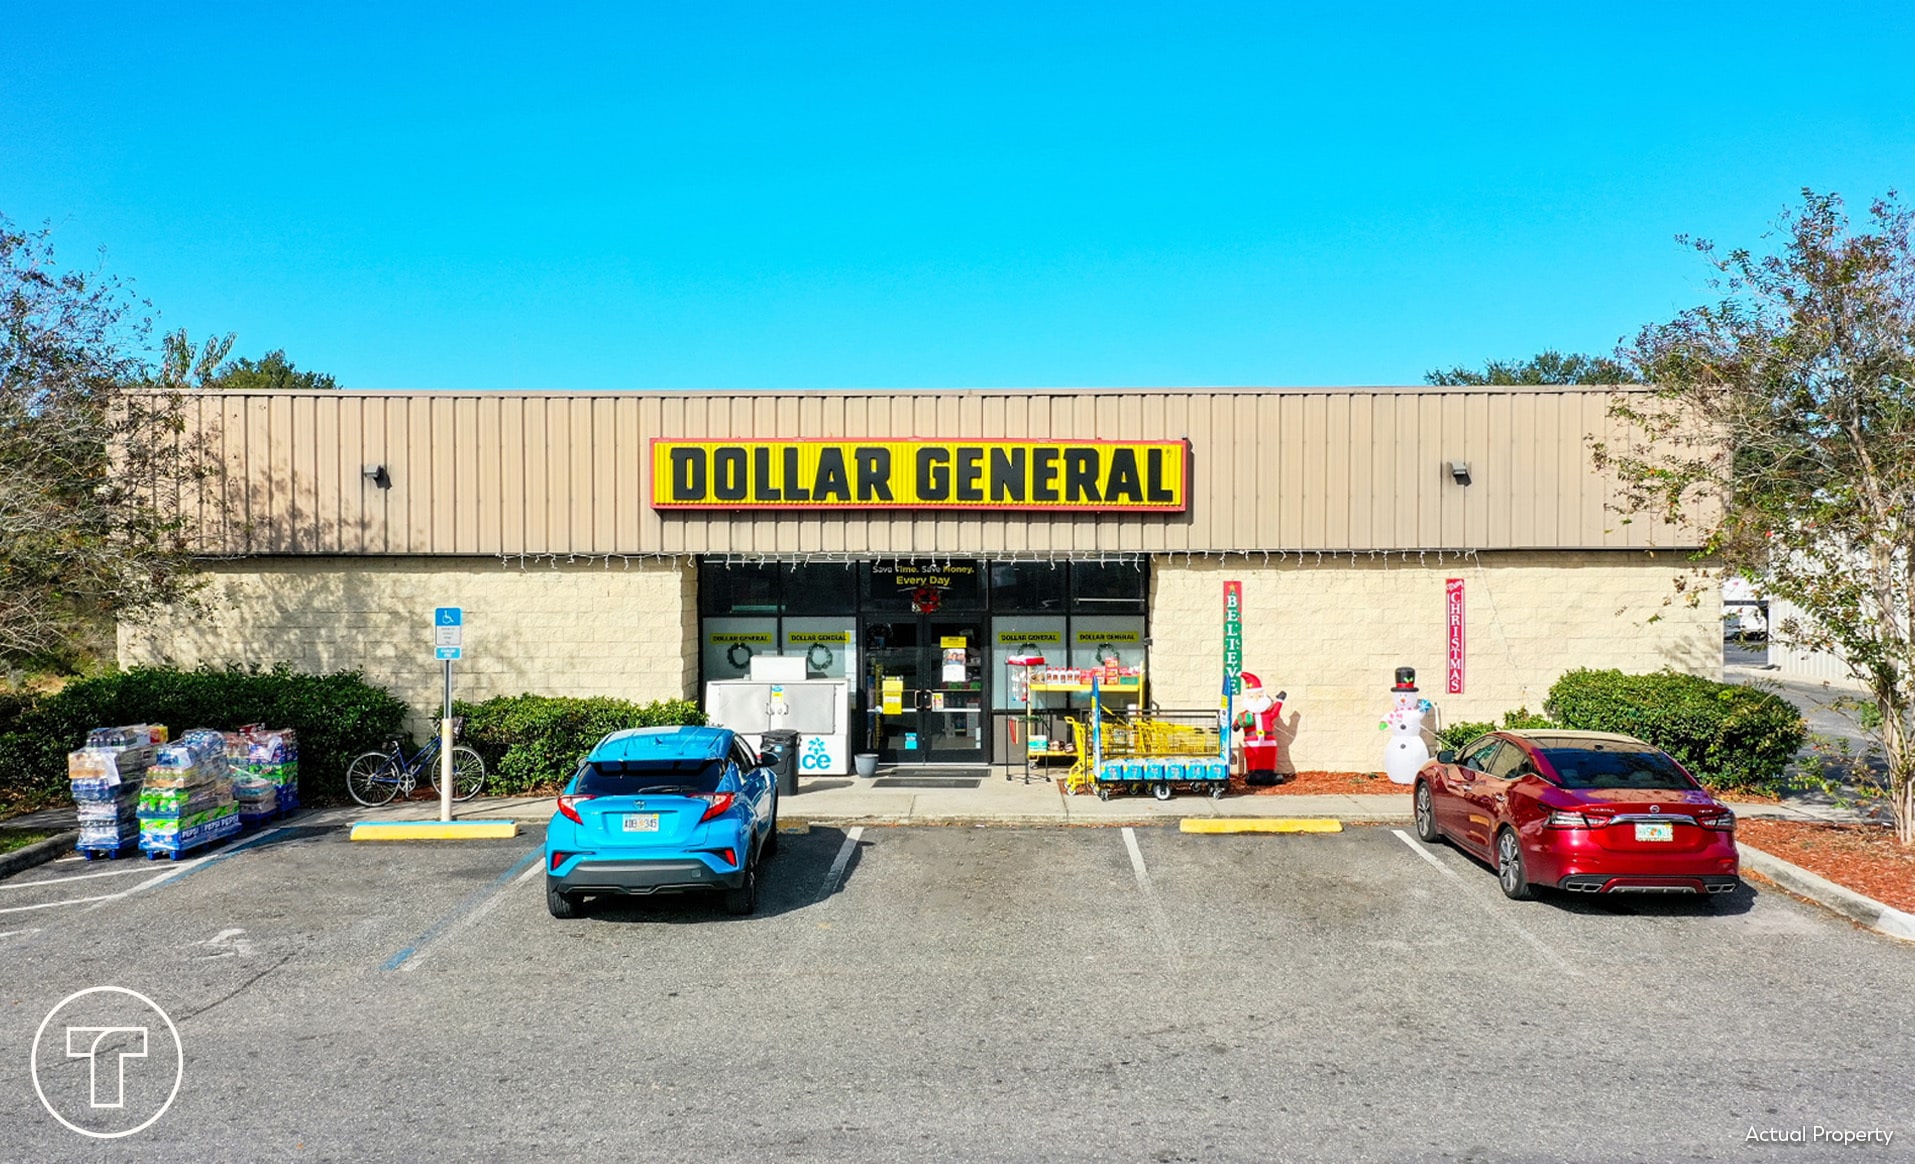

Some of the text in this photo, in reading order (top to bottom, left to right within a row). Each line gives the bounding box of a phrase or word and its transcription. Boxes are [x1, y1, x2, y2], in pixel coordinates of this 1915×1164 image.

[670, 447, 1173, 502] DOLLAR GENERAL
[872, 565, 892, 573] Save
[921, 565, 941, 573] Save
[943, 565, 975, 574] Money.
[896, 576, 926, 586] Every
[1226, 595, 1239, 693] BELIEVE
[1450, 592, 1461, 691] CHRISTMAS
[181, 815, 239, 838] PEPSI PEPSI PEPSI
